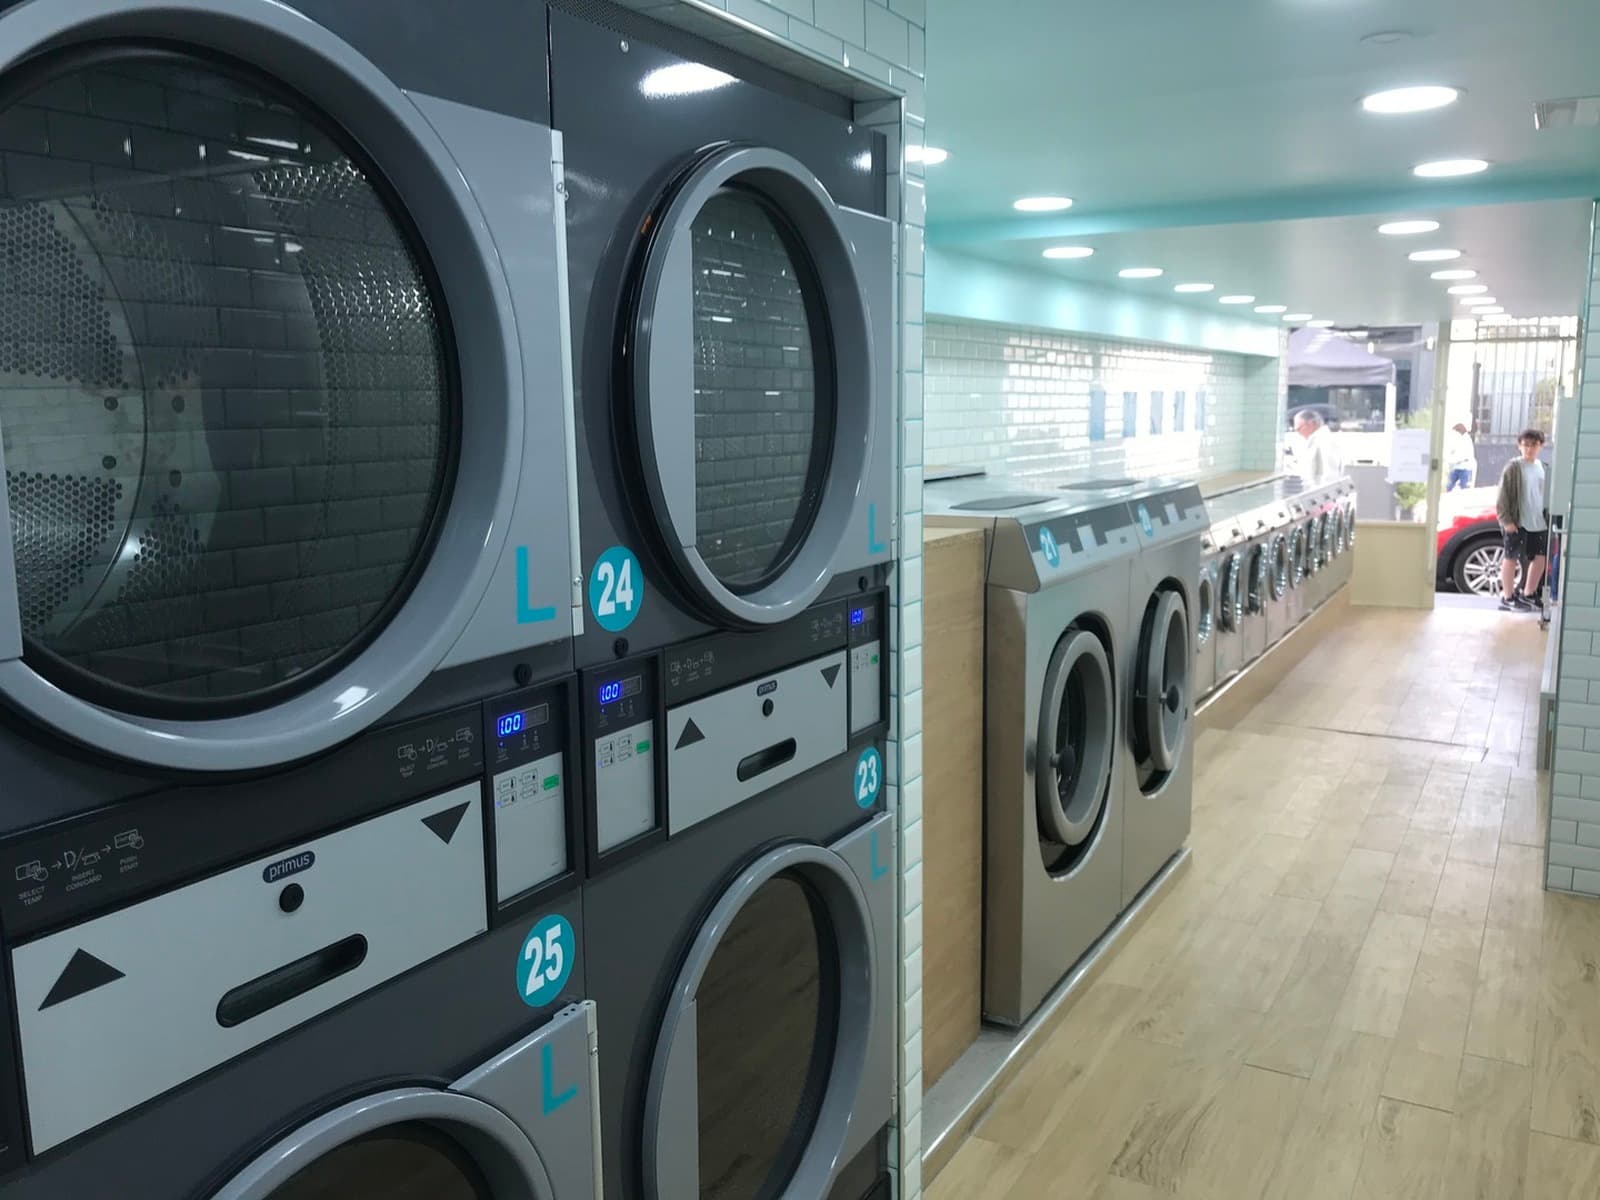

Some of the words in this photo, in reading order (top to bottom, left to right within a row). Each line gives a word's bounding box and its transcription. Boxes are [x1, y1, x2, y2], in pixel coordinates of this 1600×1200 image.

[867, 502, 886, 555] L
[1040, 530, 1058, 561] 21
[515, 545, 557, 625] L
[597, 559, 634, 616] 24
[858, 755, 877, 800] 23
[269, 854, 310, 881] primus
[870, 831, 888, 881] L
[18, 886, 46, 900] SELECT
[524, 923, 563, 995] 25
[540, 1042, 578, 1118] L
